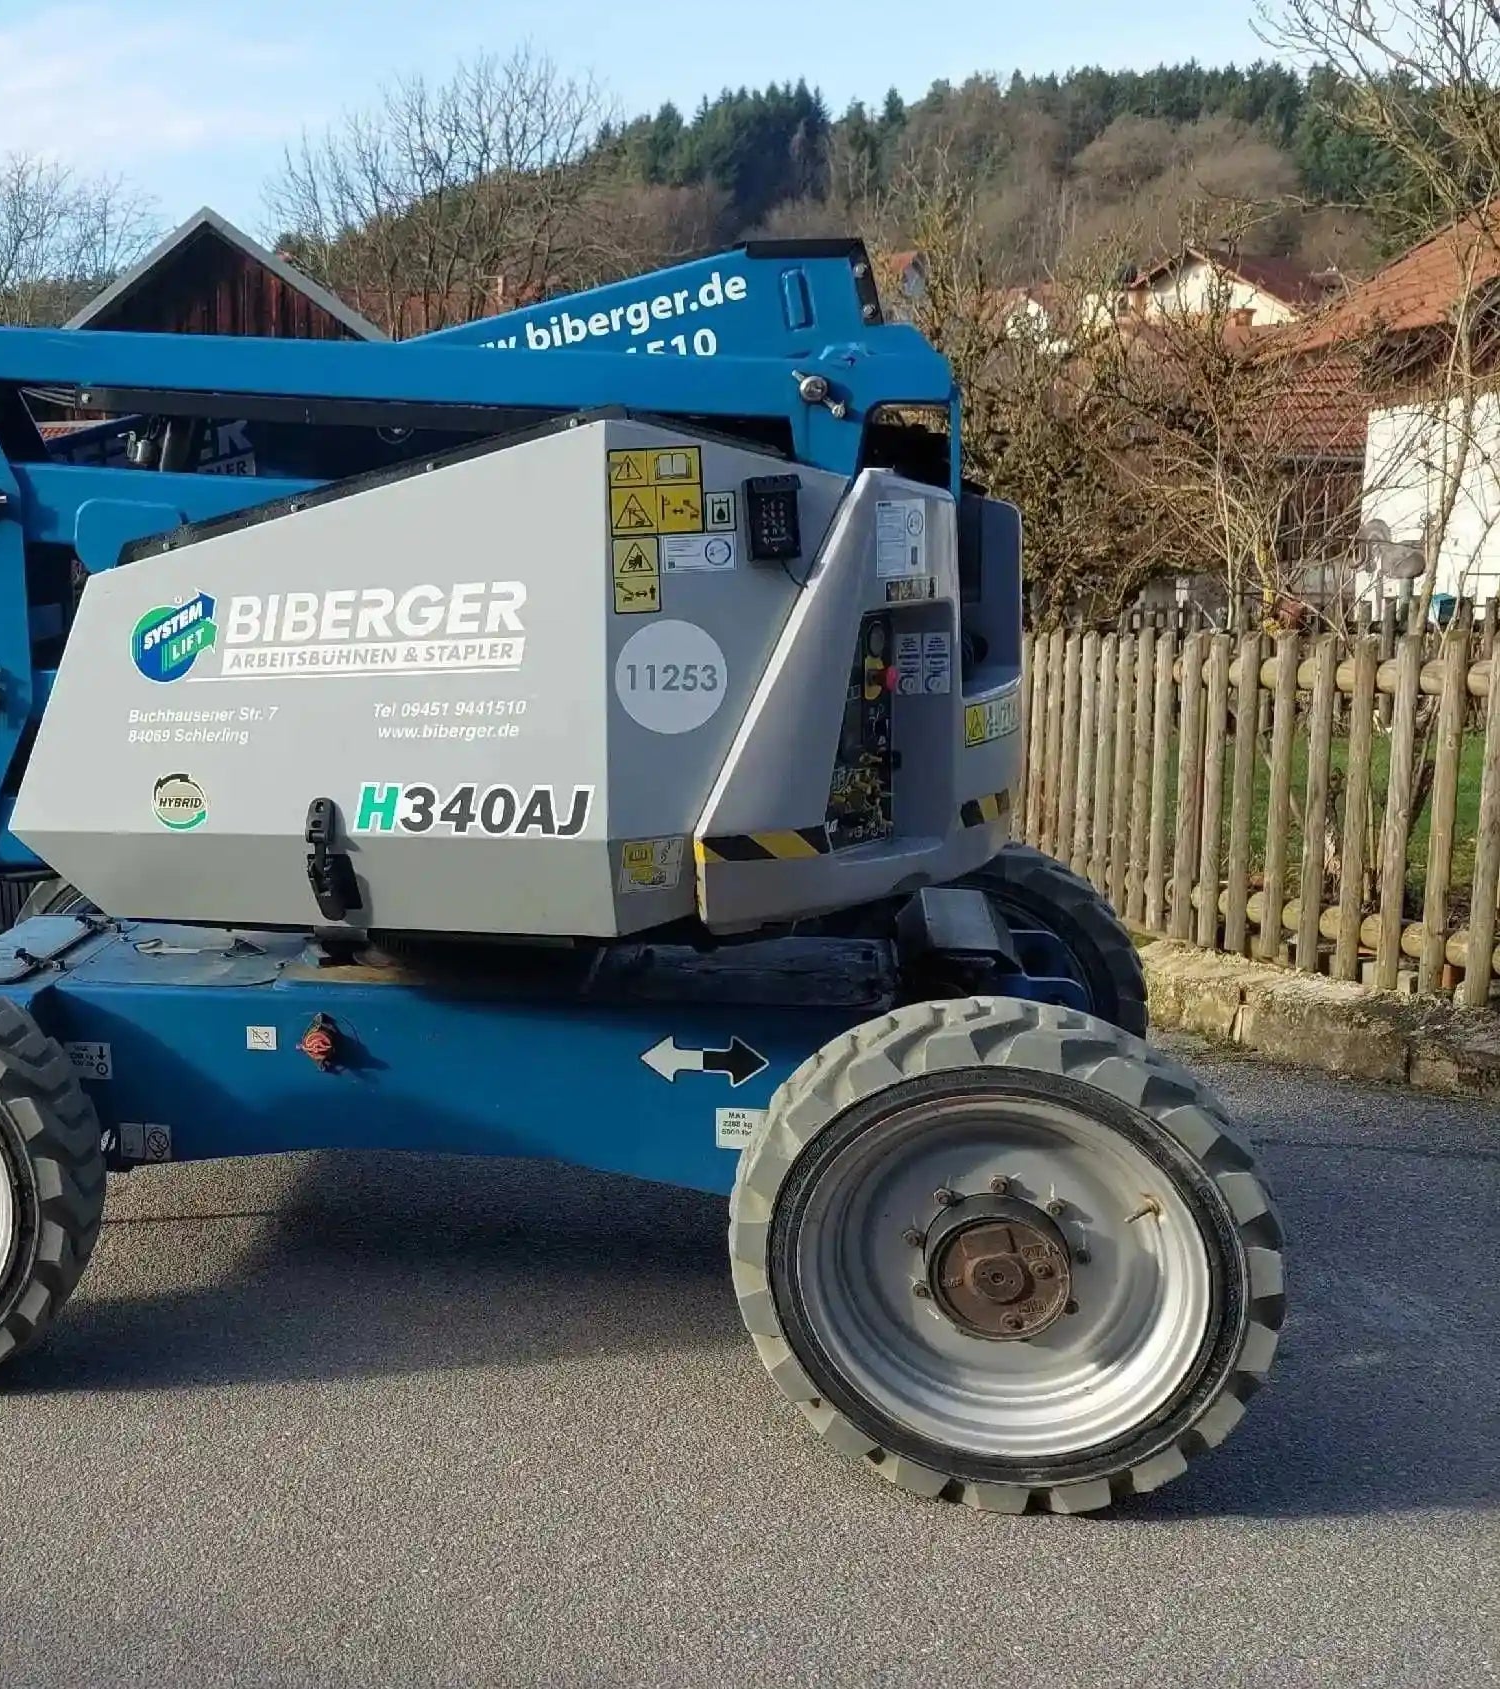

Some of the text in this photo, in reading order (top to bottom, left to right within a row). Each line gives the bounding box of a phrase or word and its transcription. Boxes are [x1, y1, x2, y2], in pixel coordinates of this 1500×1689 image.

[143, 601, 203, 650] SYSTEM
[225, 581, 527, 643] BIBERGER
[172, 627, 206, 661] LIFT
[229, 642, 514, 669] ARBEITSBÜHNEN & STAPLER
[626, 664, 718, 691] 11253
[128, 706, 279, 723] Buchhausener Str. 7
[373, 700, 527, 718] Tel 09451 9441510
[128, 729, 171, 743] 84069
[378, 722, 520, 741] www.biberger.de
[159, 797, 203, 809] HYBRID
[354, 784, 593, 837] H340AJ
